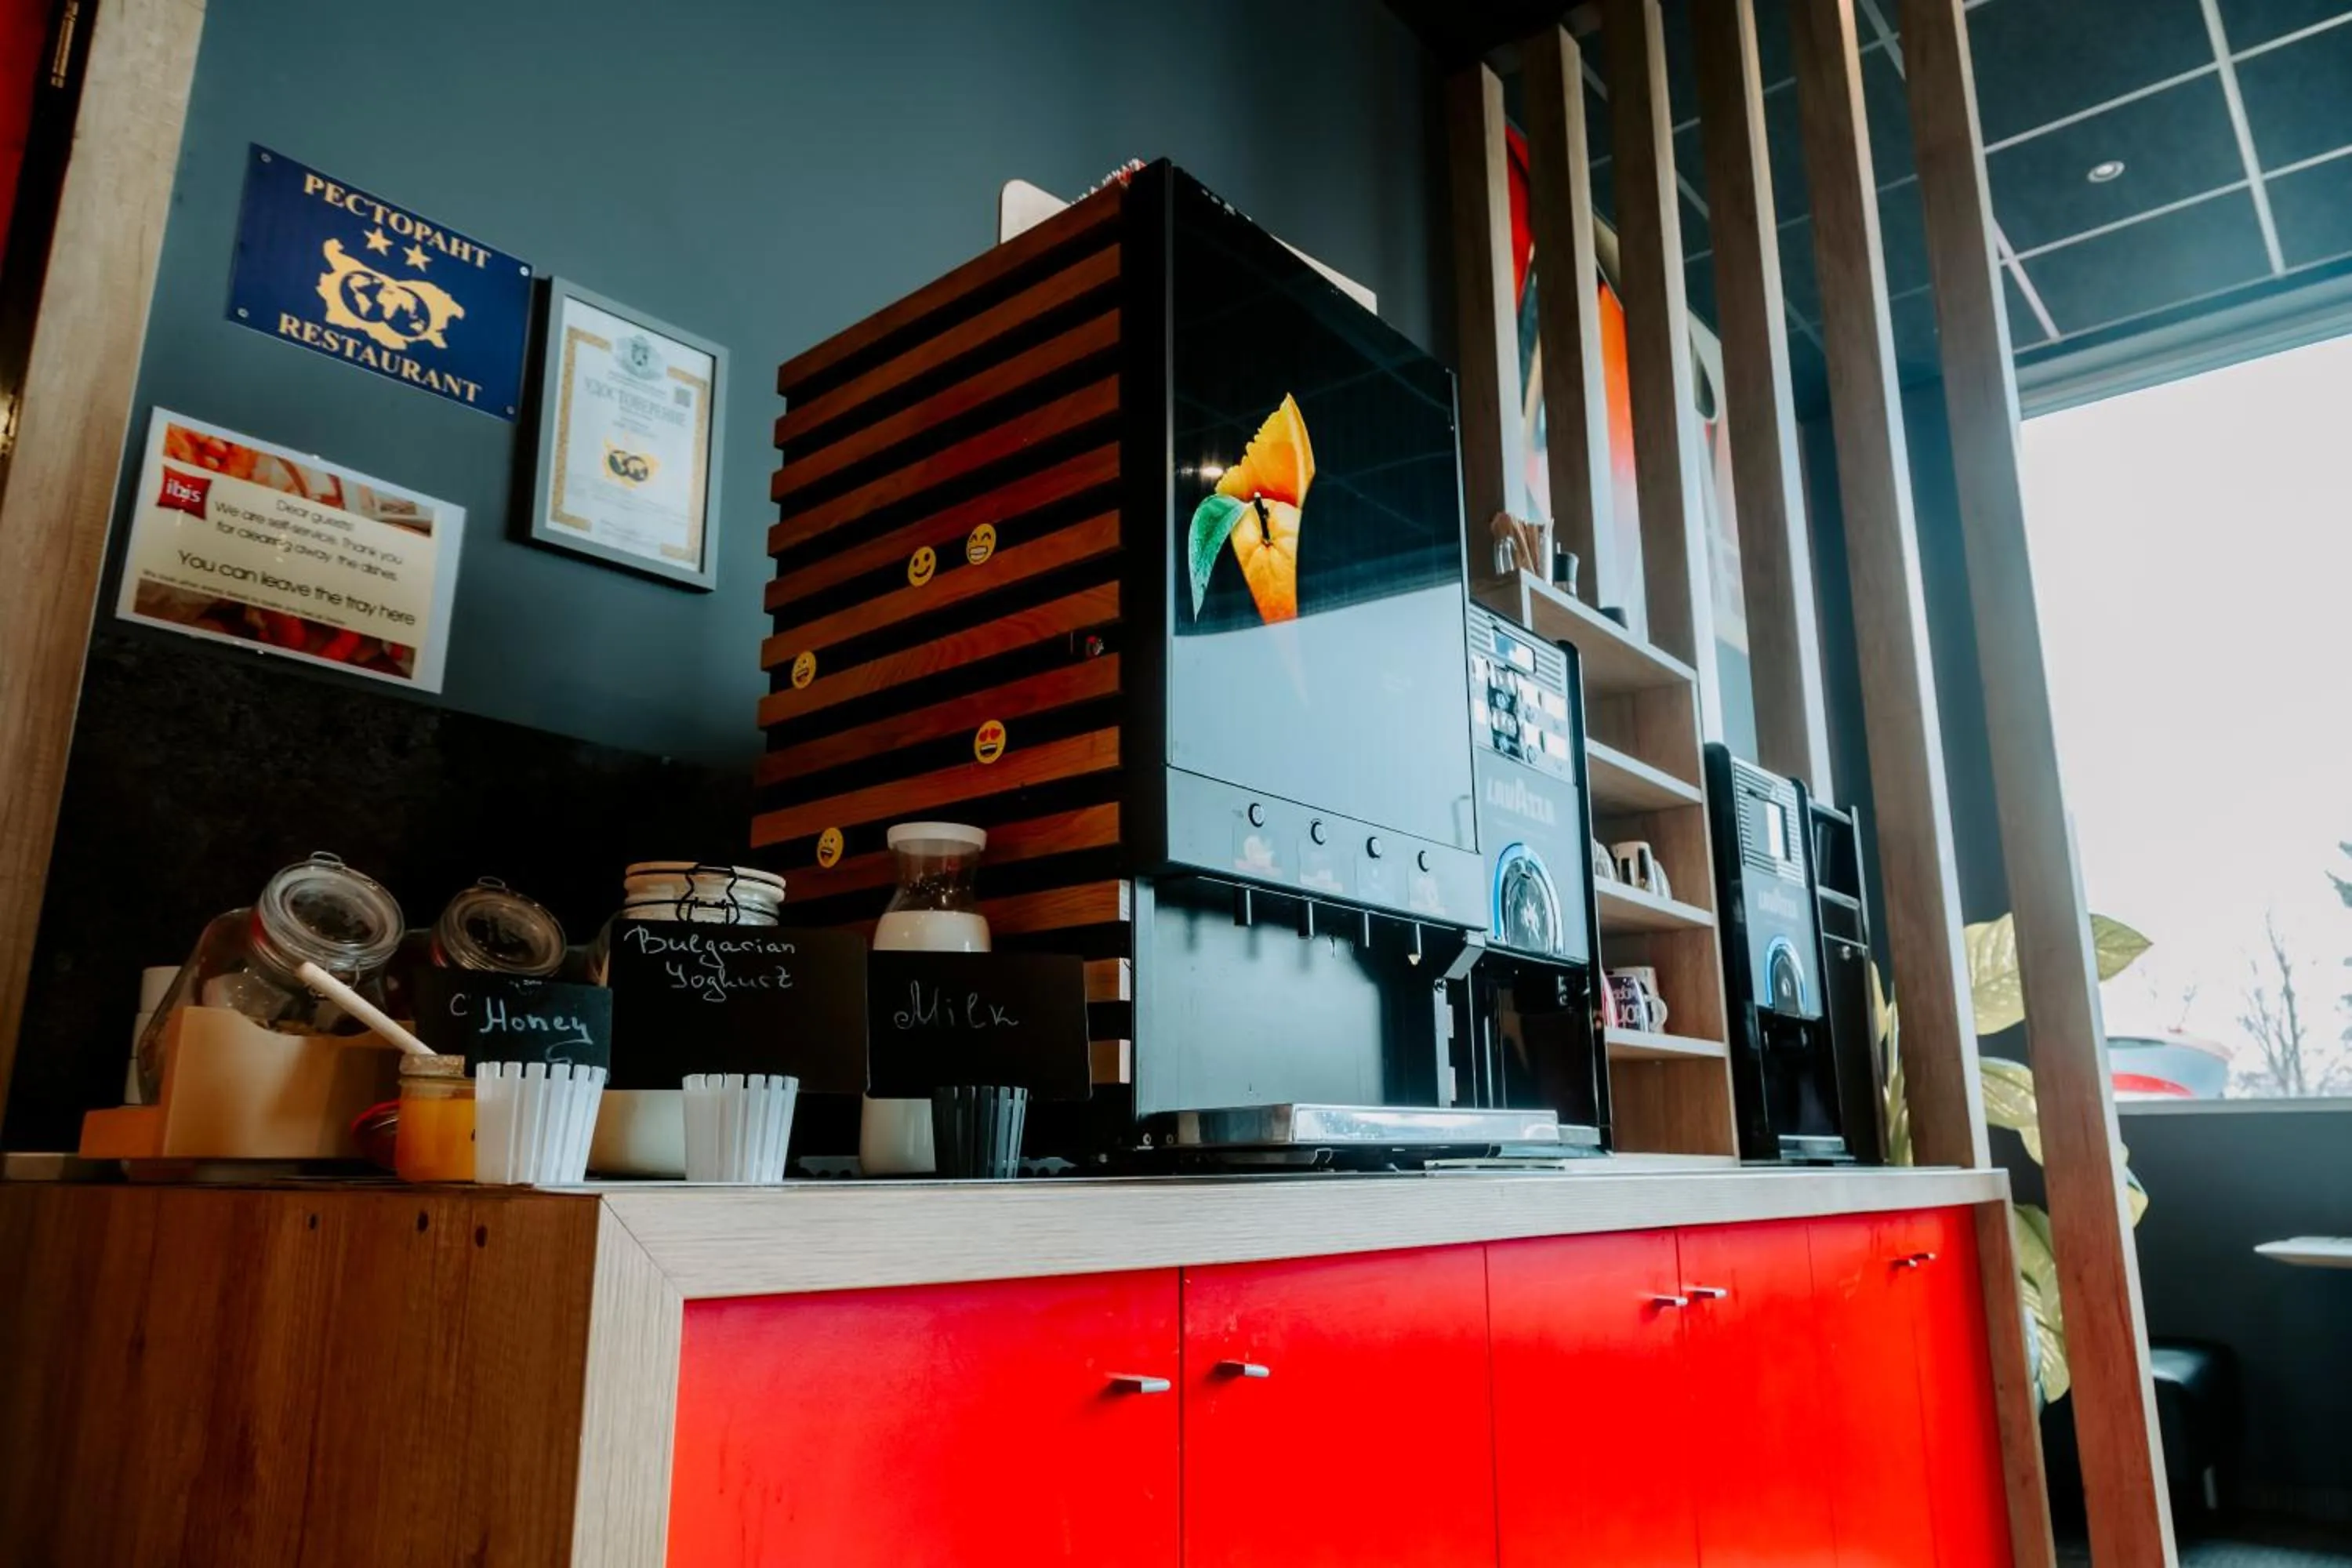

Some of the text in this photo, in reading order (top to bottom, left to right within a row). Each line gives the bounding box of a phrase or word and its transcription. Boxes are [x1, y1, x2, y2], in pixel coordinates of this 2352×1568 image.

[303, 173, 492, 270] РЕСТОРАНТ
[278, 312, 483, 403] RESTAURANT
[167, 478, 201, 503] ibis
[276, 499, 309, 518] Dear
[214, 500, 239, 517] We
[241, 510, 265, 524] are
[343, 536, 376, 557] Thank
[379, 550, 403, 566] you
[216, 520, 235, 535] for
[294, 543, 332, 563] away
[337, 554, 358, 569] the
[177, 548, 215, 573] You
[218, 563, 257, 583] can
[260, 570, 311, 597] leave
[314, 585, 343, 606] the
[346, 594, 378, 618] tray
[379, 602, 416, 626] here
[623, 924, 796, 968] Bulgarian
[479, 996, 593, 1065] Honey
[893, 978, 1019, 1029] Milk
